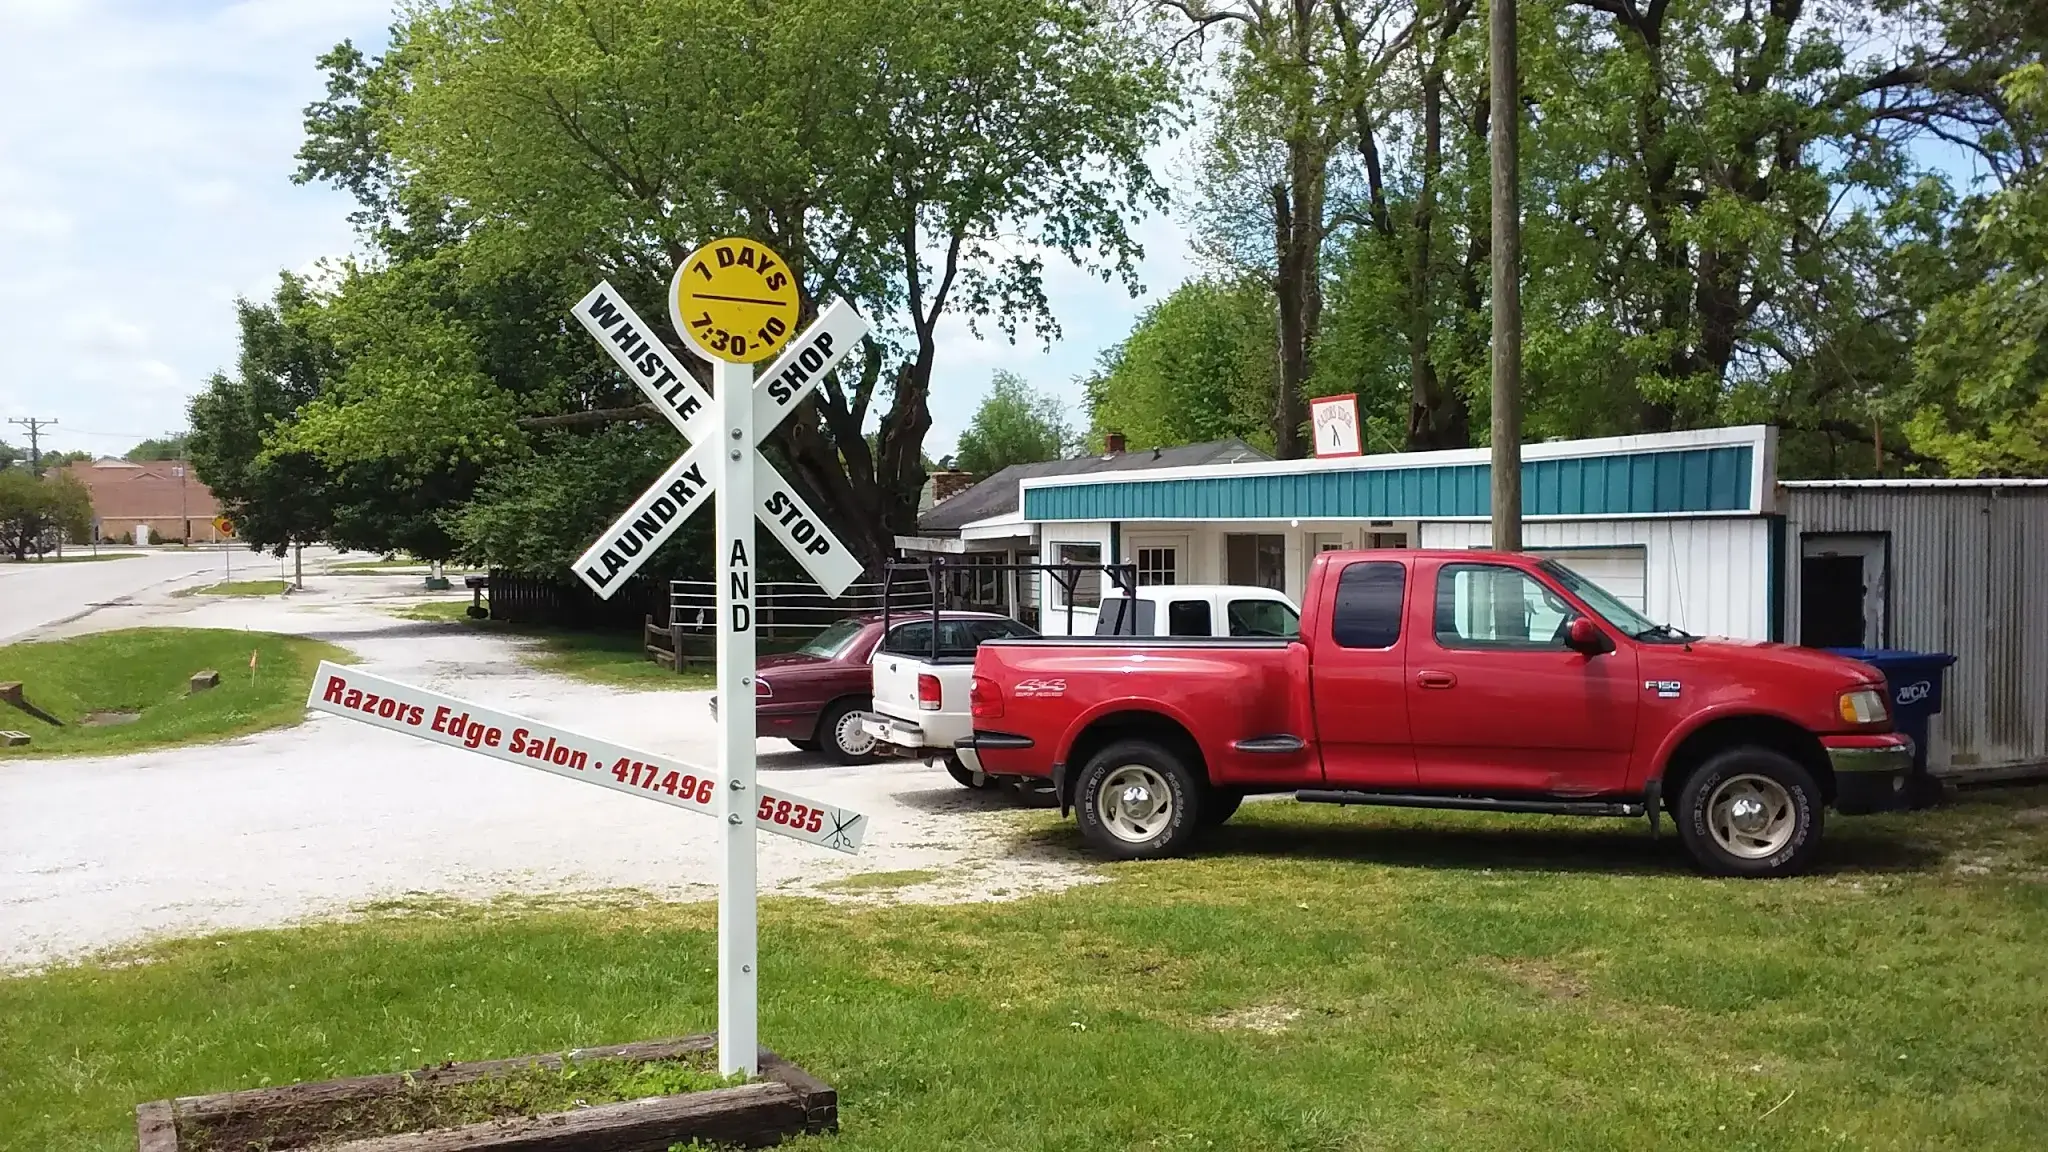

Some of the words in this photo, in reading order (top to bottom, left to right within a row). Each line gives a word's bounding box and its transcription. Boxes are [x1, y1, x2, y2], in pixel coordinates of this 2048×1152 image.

[692, 260, 713, 282] 7
[715, 246, 788, 292] DAYS
[691, 311, 786, 357] 7:30-10
[585, 461, 708, 589] LAUNDRY
[767, 330, 834, 406] SHOP
[587, 293, 702, 422] WHISTLE
[764, 490, 831, 557] STOP
[729, 539, 750, 633] AND
[1900, 686, 1928, 700] WCA
[323, 675, 424, 726] Razors
[431, 705, 502, 749] Edge
[508, 727, 588, 770] Salon
[757, 795, 825, 834] 5835
